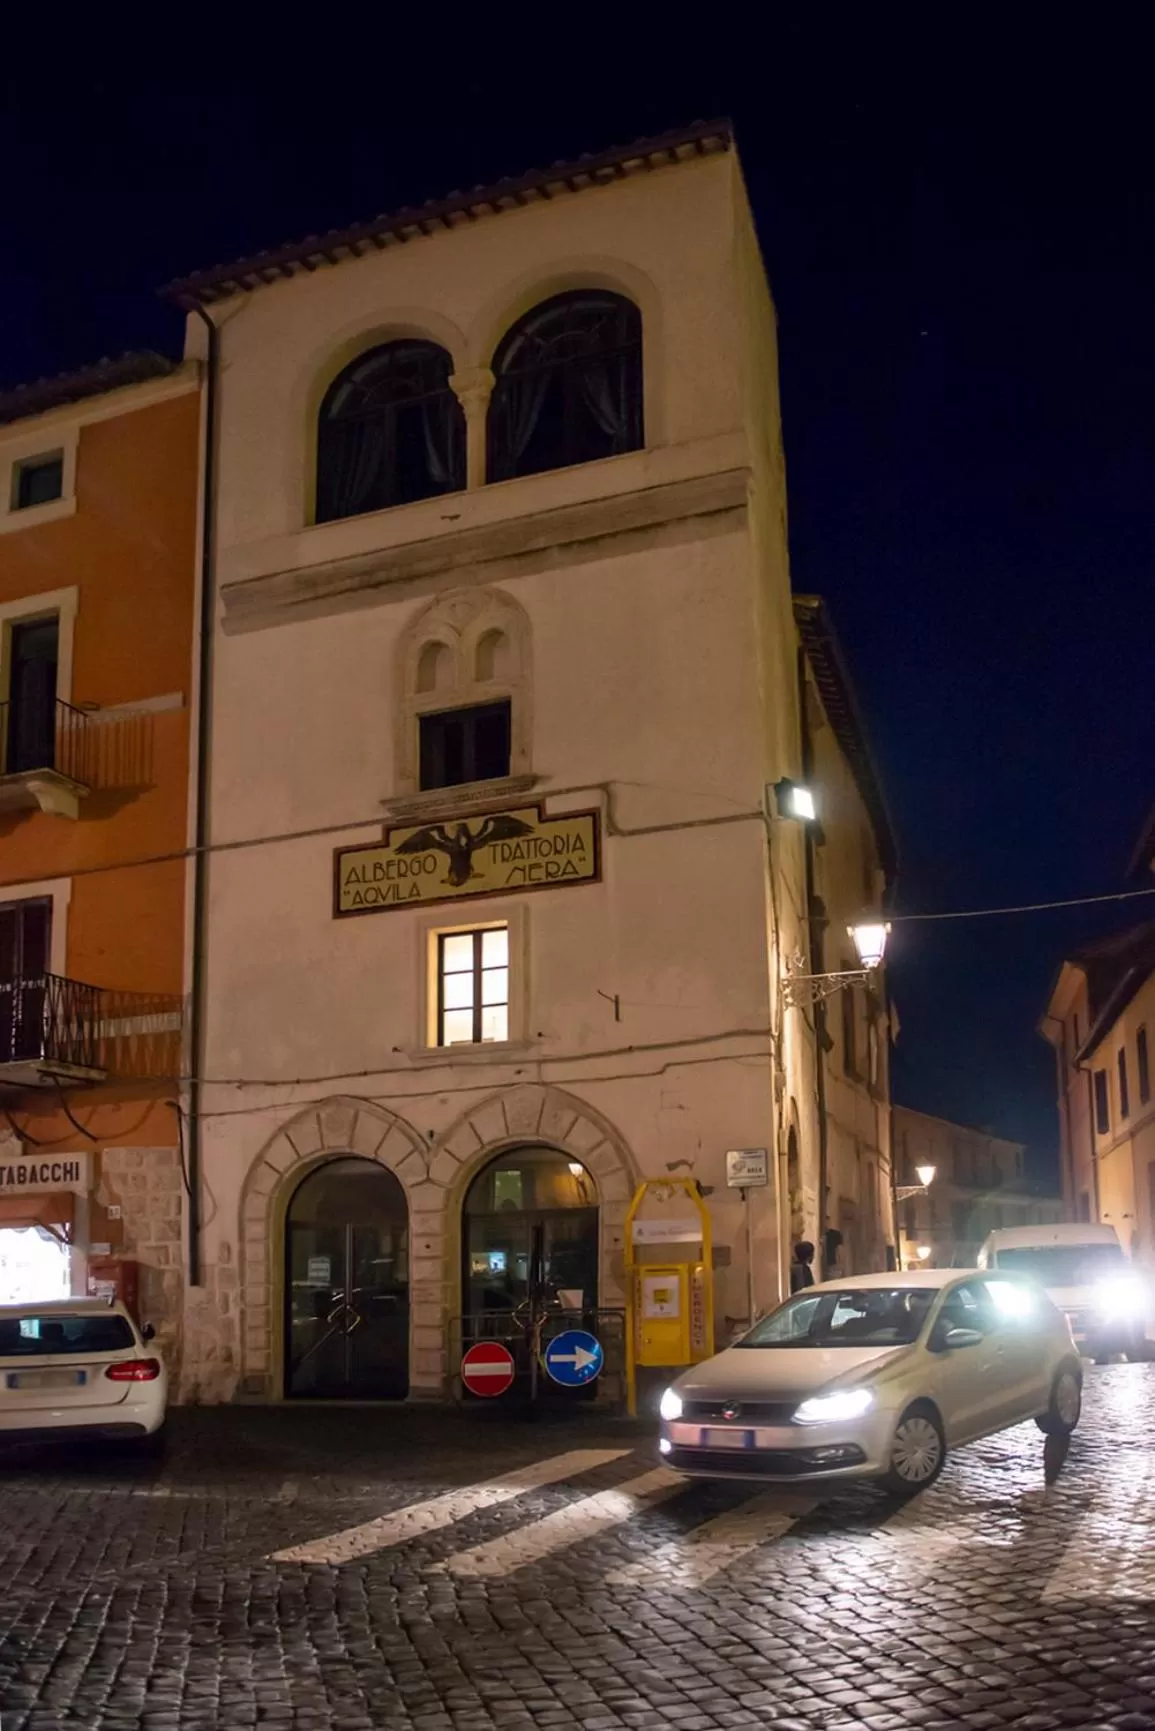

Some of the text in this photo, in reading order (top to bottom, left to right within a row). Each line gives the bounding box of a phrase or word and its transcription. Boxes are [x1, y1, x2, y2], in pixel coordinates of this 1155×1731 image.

[344, 832, 586, 886] ALBERGO TRATTORIA
[0, 1161, 80, 1186] TABACCHI
